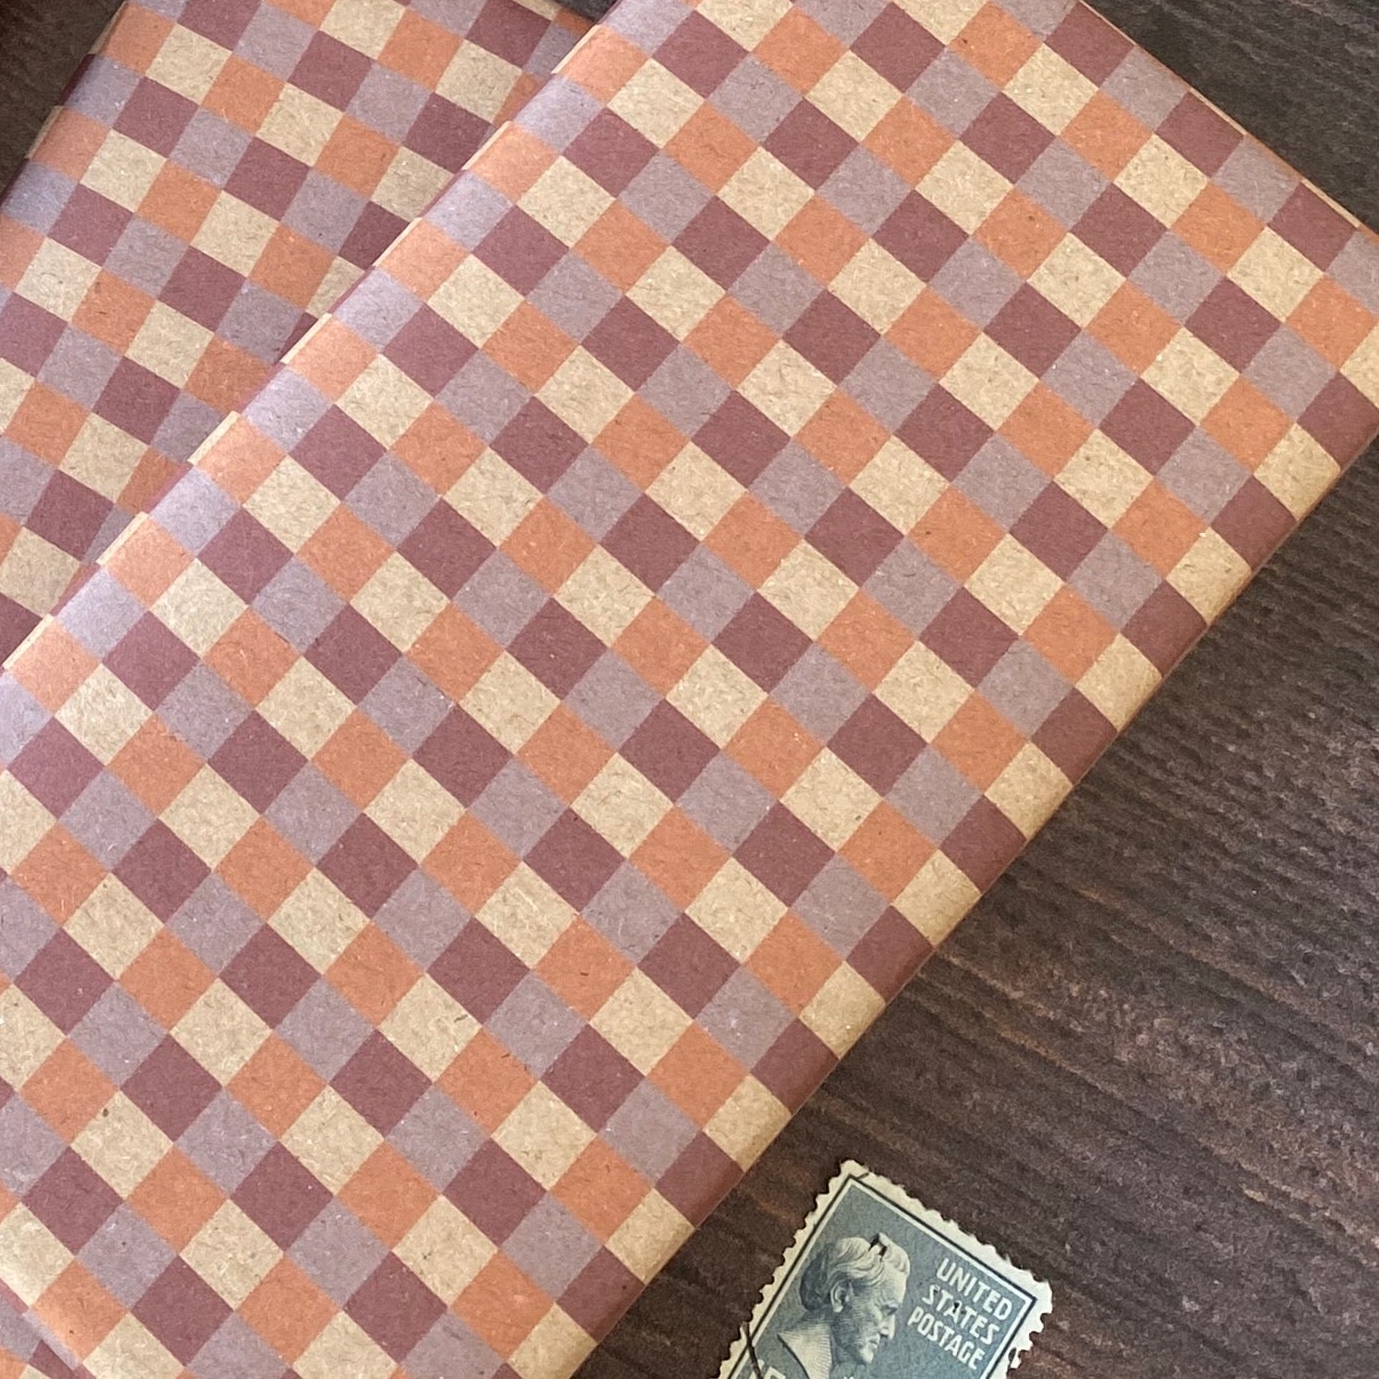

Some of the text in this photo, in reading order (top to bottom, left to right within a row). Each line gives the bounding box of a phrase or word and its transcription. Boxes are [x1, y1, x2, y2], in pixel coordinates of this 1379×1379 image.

[921, 1284, 1001, 1346] STATES
[936, 1257, 1013, 1321] UNITED
[907, 1306, 986, 1371] POSTAGE
